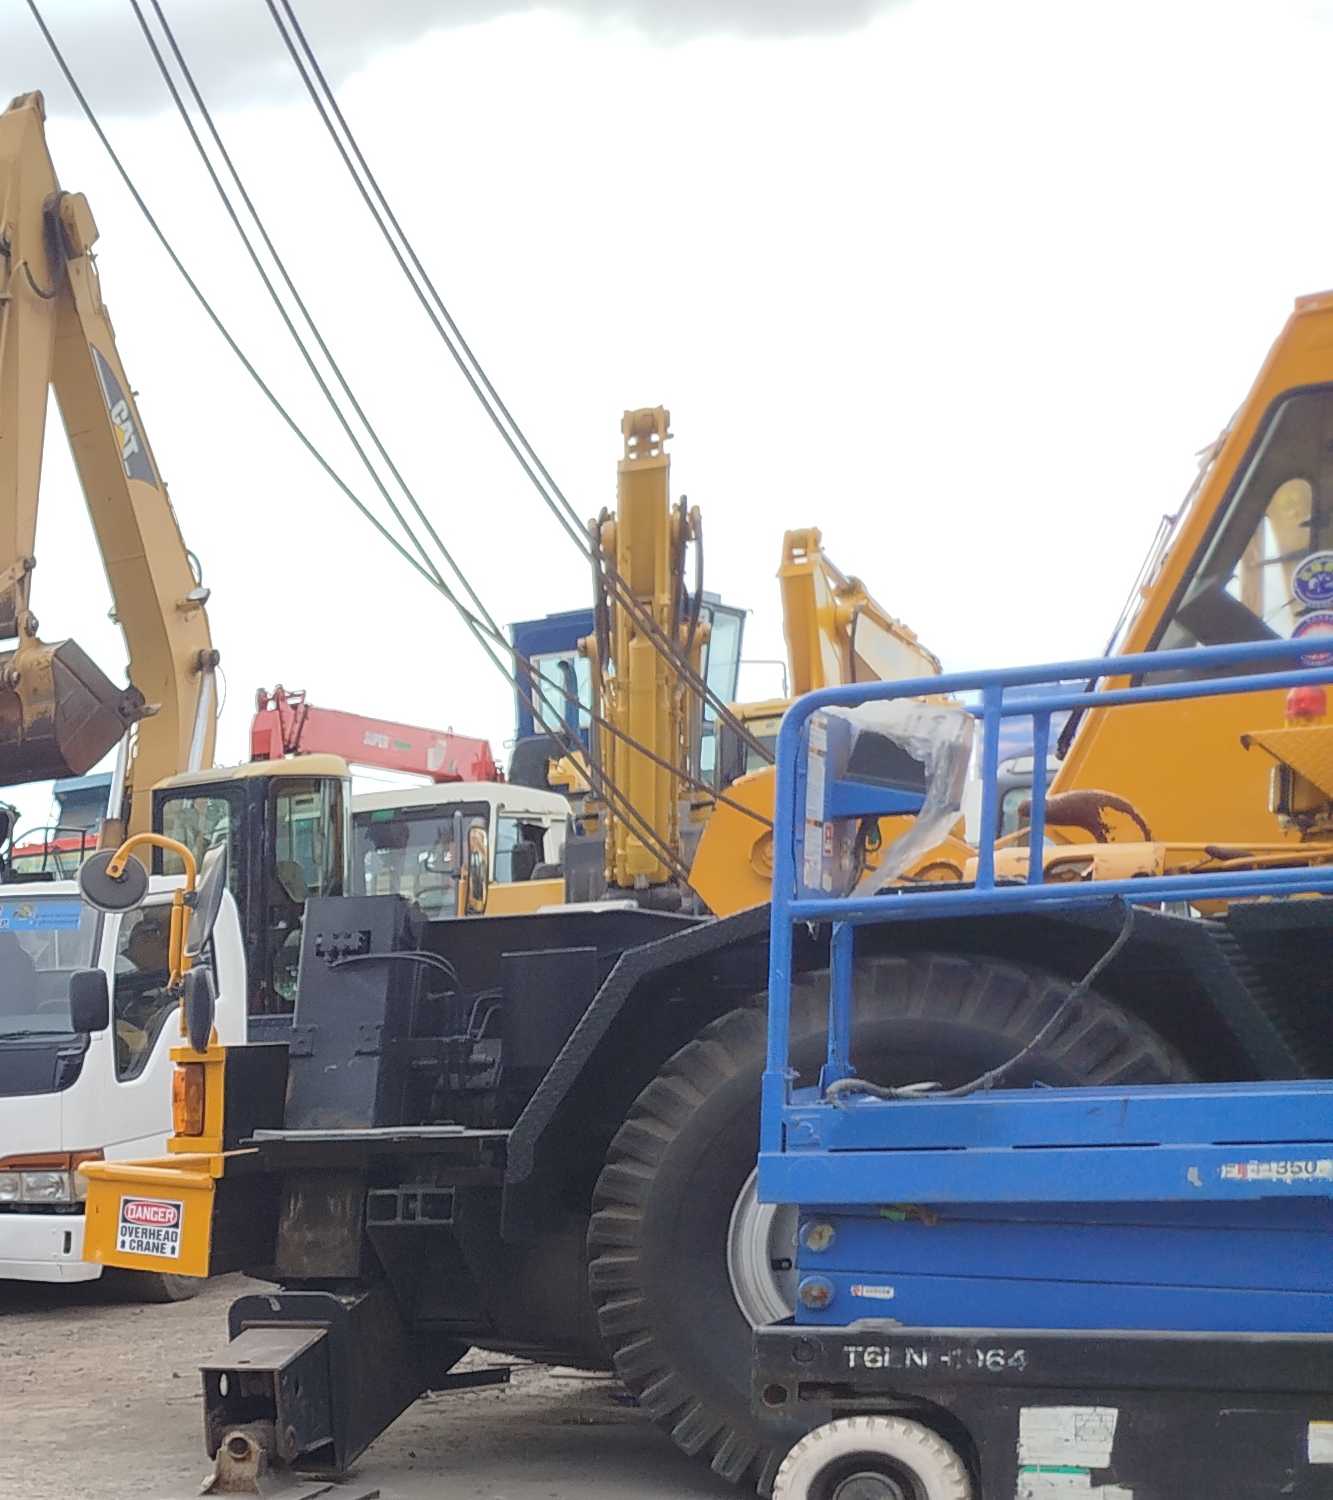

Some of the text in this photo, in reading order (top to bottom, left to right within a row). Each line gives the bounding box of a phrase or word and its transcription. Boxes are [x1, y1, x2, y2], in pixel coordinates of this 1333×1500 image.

[111, 399, 139, 460] CAT
[127, 1204, 174, 1223] DANGER
[120, 1225, 179, 1243] OVERHEAD
[129, 1239, 167, 1254] CRANE
